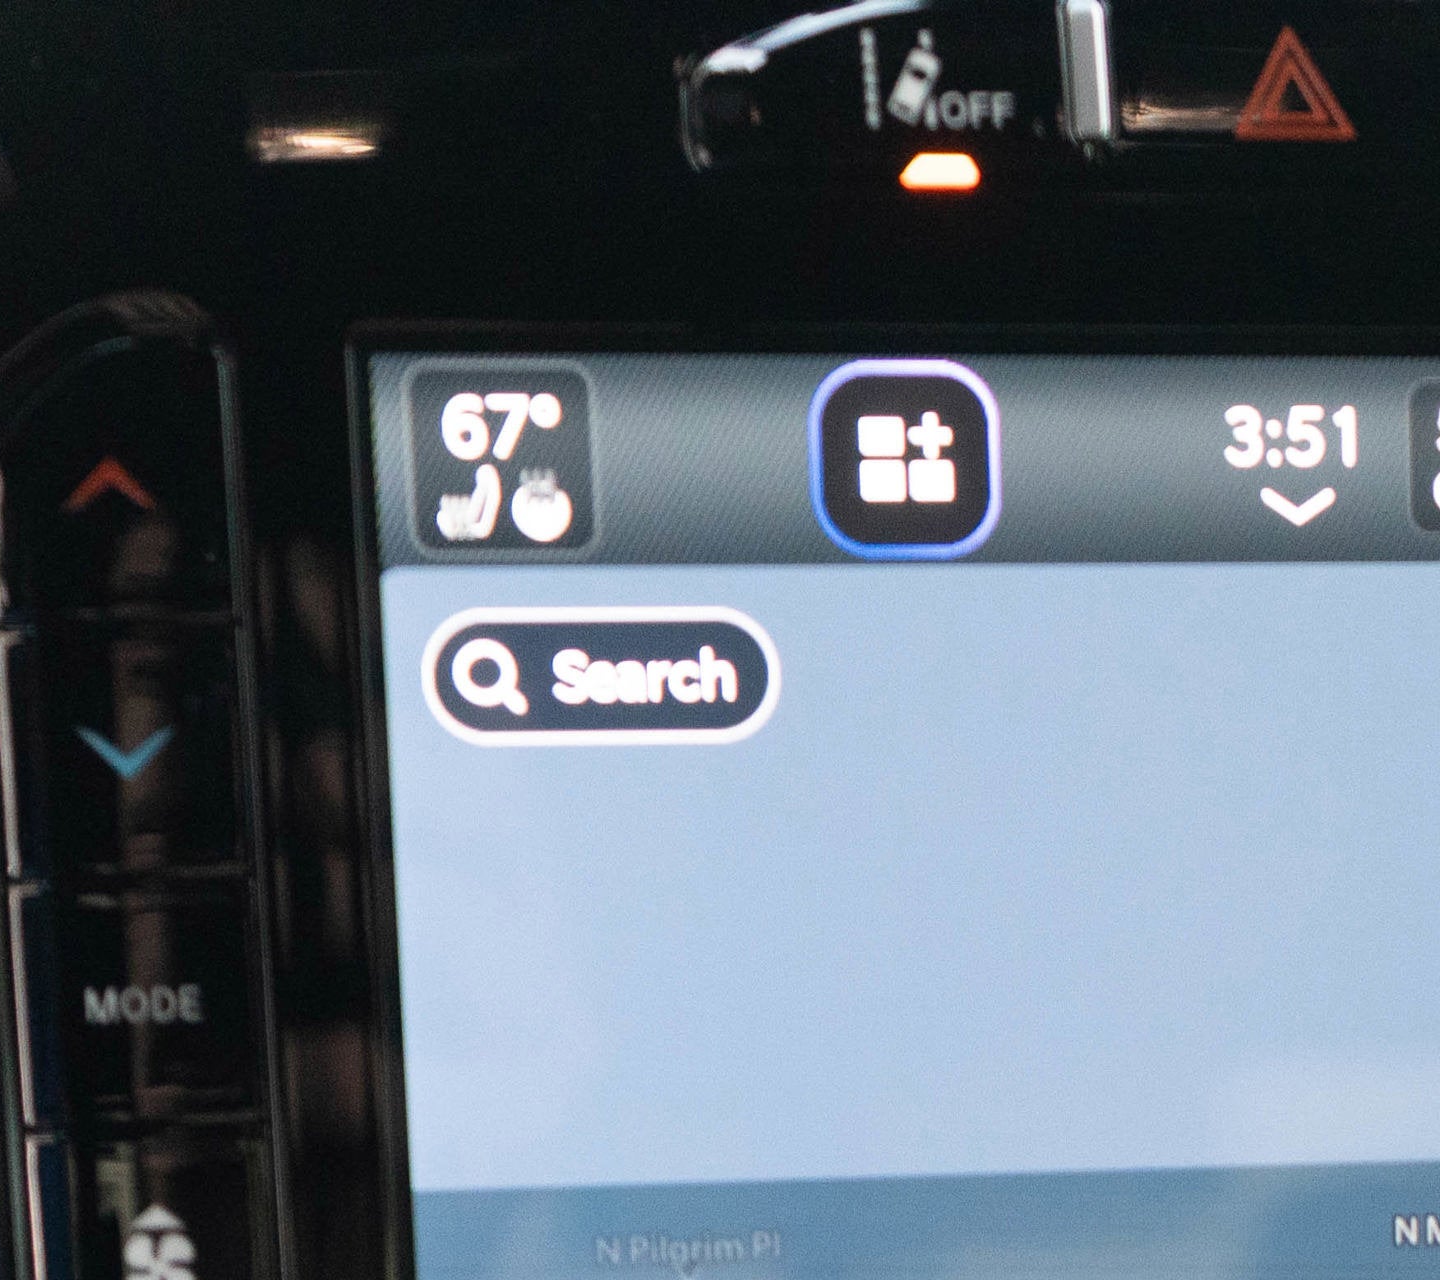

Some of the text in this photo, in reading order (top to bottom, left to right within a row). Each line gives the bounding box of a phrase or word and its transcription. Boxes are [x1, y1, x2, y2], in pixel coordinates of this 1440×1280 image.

[938, 90, 1015, 130] OFF
[1223, 404, 1358, 470] 3:51
[551, 645, 738, 706] Search
[83, 983, 205, 1024] MODE
[1394, 1217, 1417, 1246] N
[629, 1234, 744, 1270] Pilgrim
